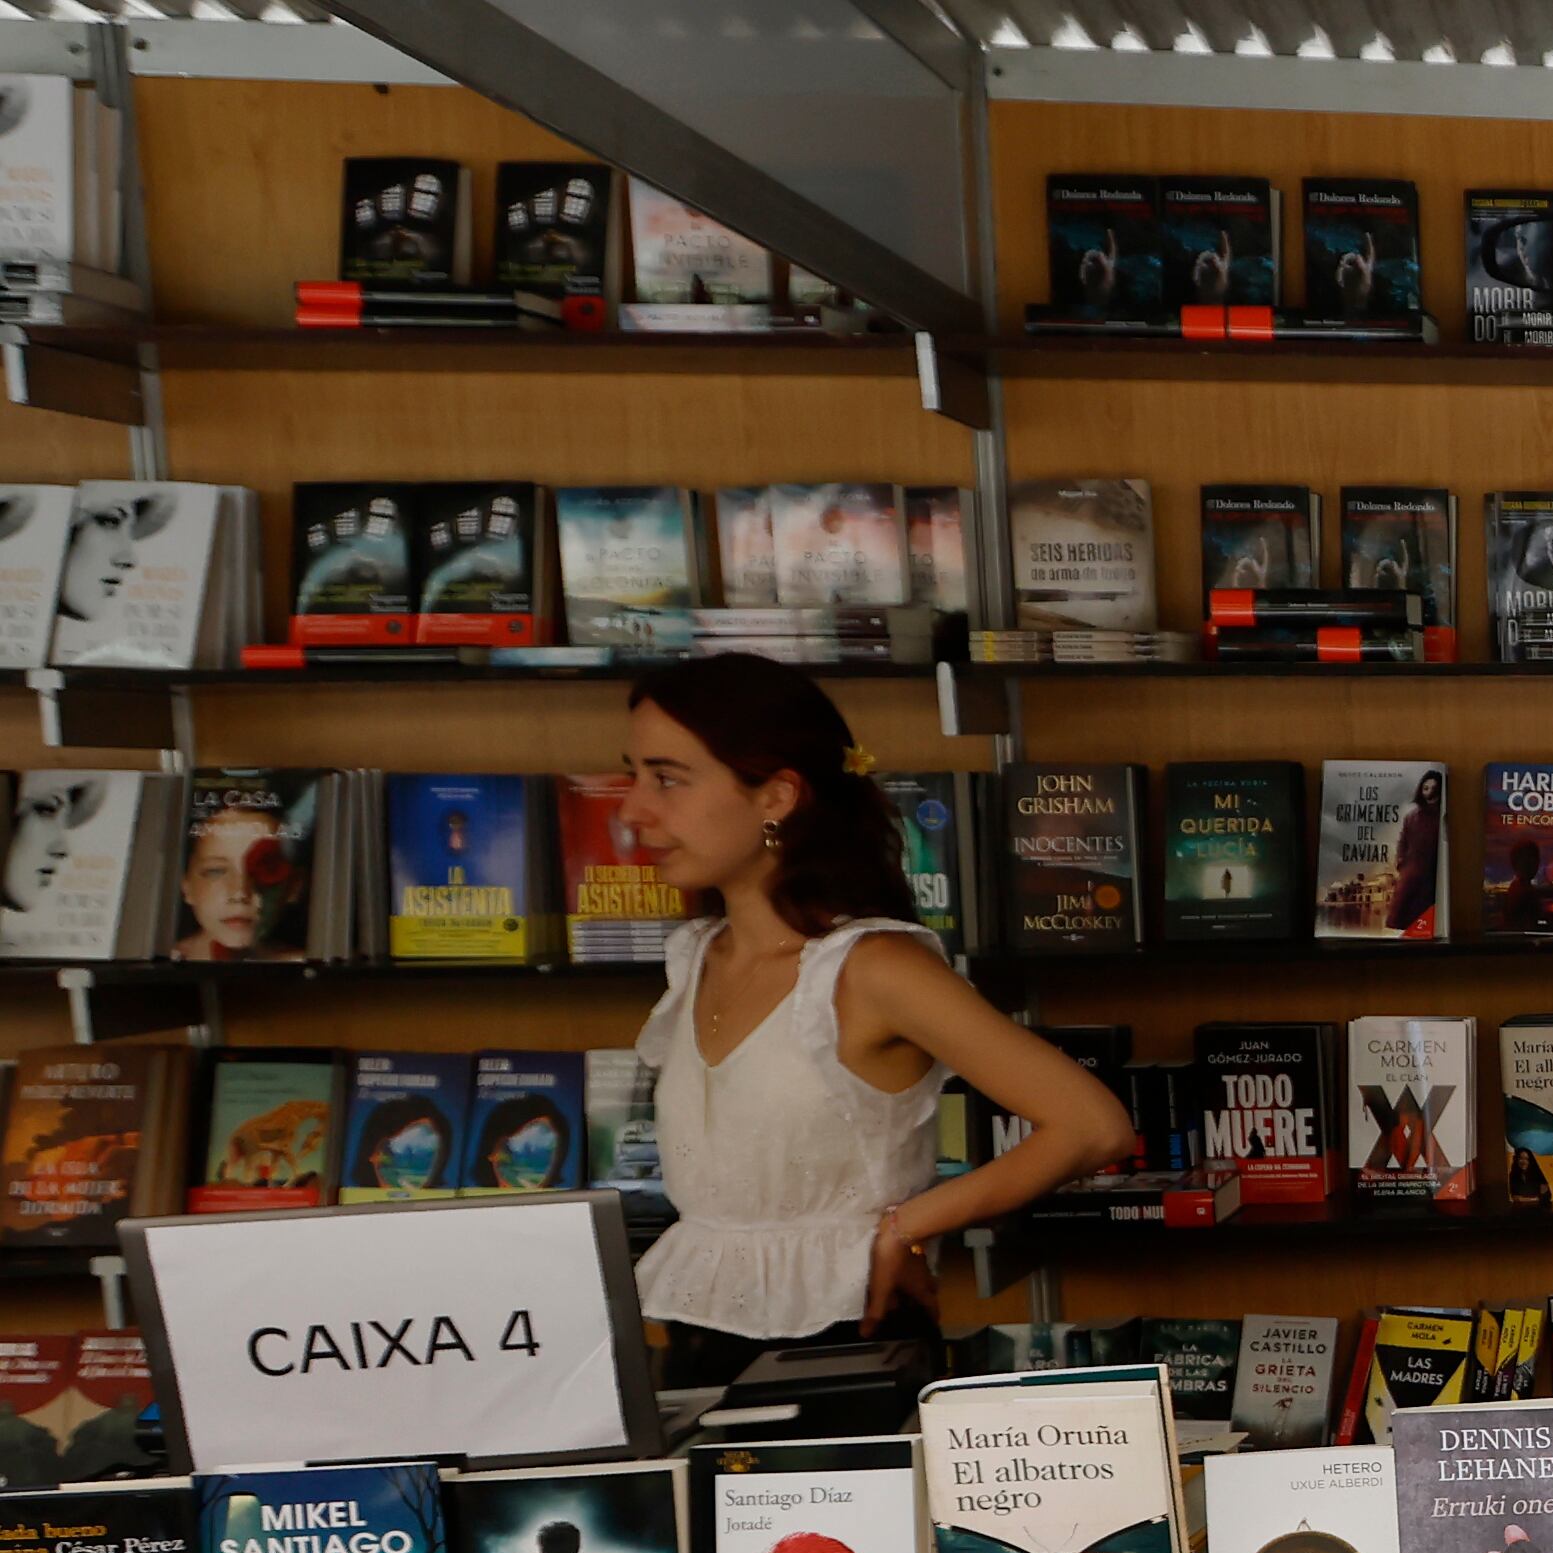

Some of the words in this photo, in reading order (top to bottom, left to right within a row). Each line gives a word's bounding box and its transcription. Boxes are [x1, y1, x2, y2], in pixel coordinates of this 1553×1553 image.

[1037, 775, 1092, 794] JOHN
[1017, 798, 1115, 816] GRISHAM
[1239, 1041, 1269, 1050] JUAN
[1208, 1052, 1302, 1064] GÓMEZ-JURADO
[1222, 1074, 1293, 1109] TODO
[1205, 1108, 1317, 1159] MUERE
[247, 1315, 474, 1376] CAIXA
[500, 1310, 540, 1357] 4
[948, 1425, 1030, 1451] María
[1037, 1424, 1128, 1447] Oruña
[1439, 1426, 1551, 1452] DENNIS
[953, 1461, 985, 1485] El
[995, 1460, 1114, 1483] albatros
[1322, 1462, 1382, 1474] HETERO
[1290, 1479, 1325, 1490] UXUE
[1328, 1476, 1383, 1489] ALBERDI
[724, 1488, 803, 1508] Santiago
[809, 1487, 853, 1506] Díaz
[956, 1490, 1042, 1515] negro
[1432, 1496, 1507, 1518] Erruki
[261, 1501, 367, 1531] MIKEL
